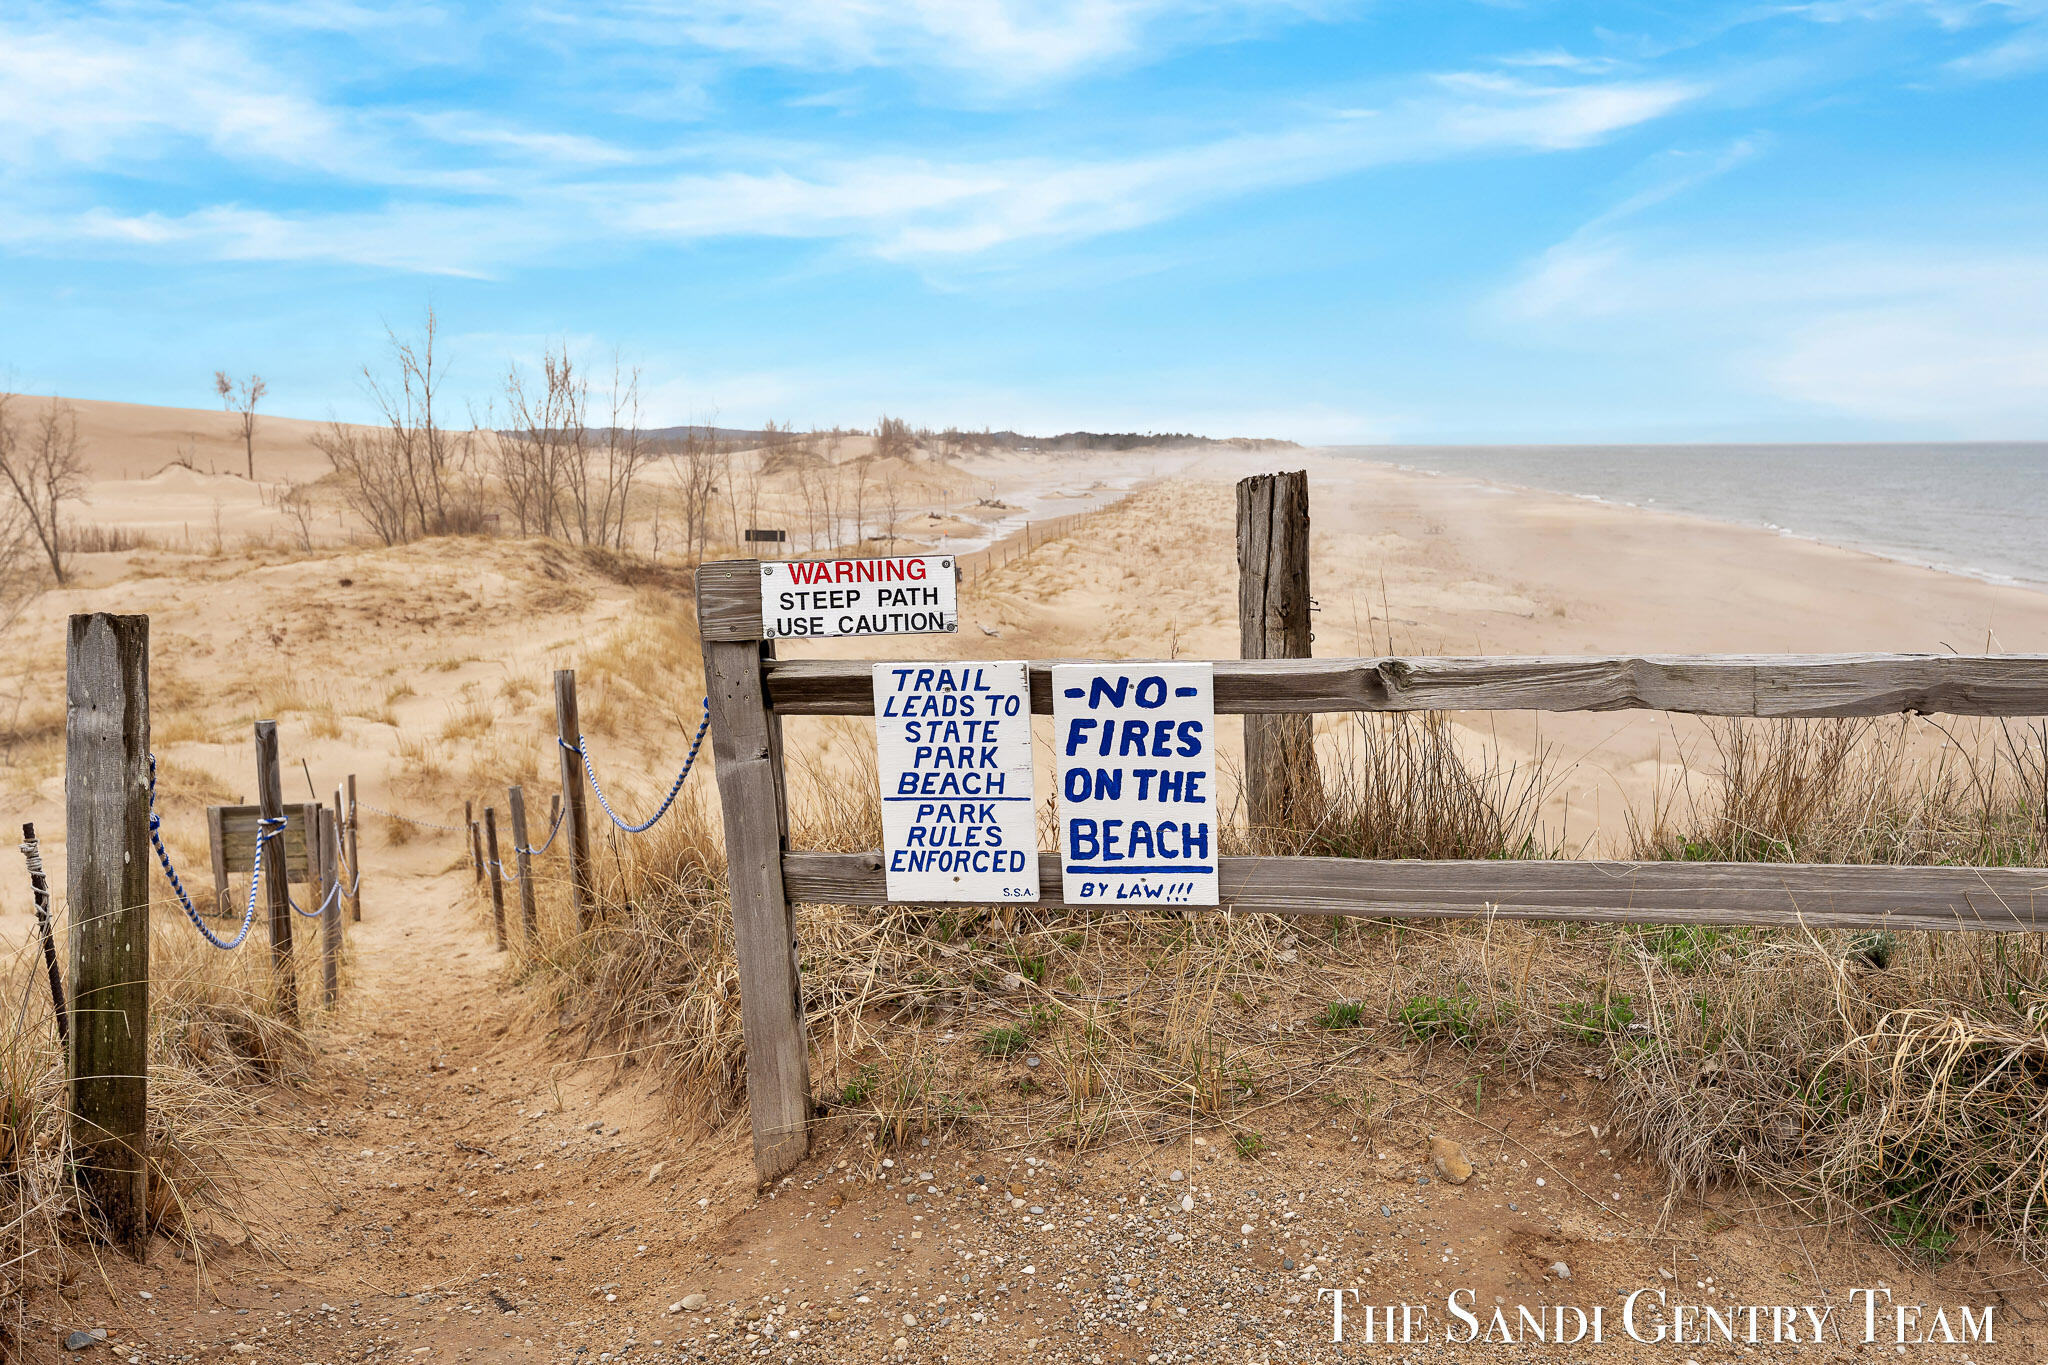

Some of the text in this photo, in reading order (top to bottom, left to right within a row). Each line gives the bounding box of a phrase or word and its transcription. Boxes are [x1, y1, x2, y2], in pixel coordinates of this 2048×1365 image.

[788, 559, 926, 584] WARNING
[780, 587, 938, 611] STEEP PATH
[777, 612, 944, 636] USE CAUTION
[892, 669, 991, 692] TRAIL
[883, 695, 1020, 717] LEADS TO
[905, 721, 1000, 743] STATE
[1066, 718, 1203, 757] FIRES
[914, 746, 999, 769] PARK
[898, 772, 1005, 795] BEACH
[1065, 767, 1206, 803] ON THE
[916, 804, 997, 824] PARK
[906, 826, 1002, 847] RULES
[1070, 818, 1208, 861] BEACH
[890, 850, 1025, 873] ENFORCED
[1080, 882, 1193, 902] BY LAW!!!
